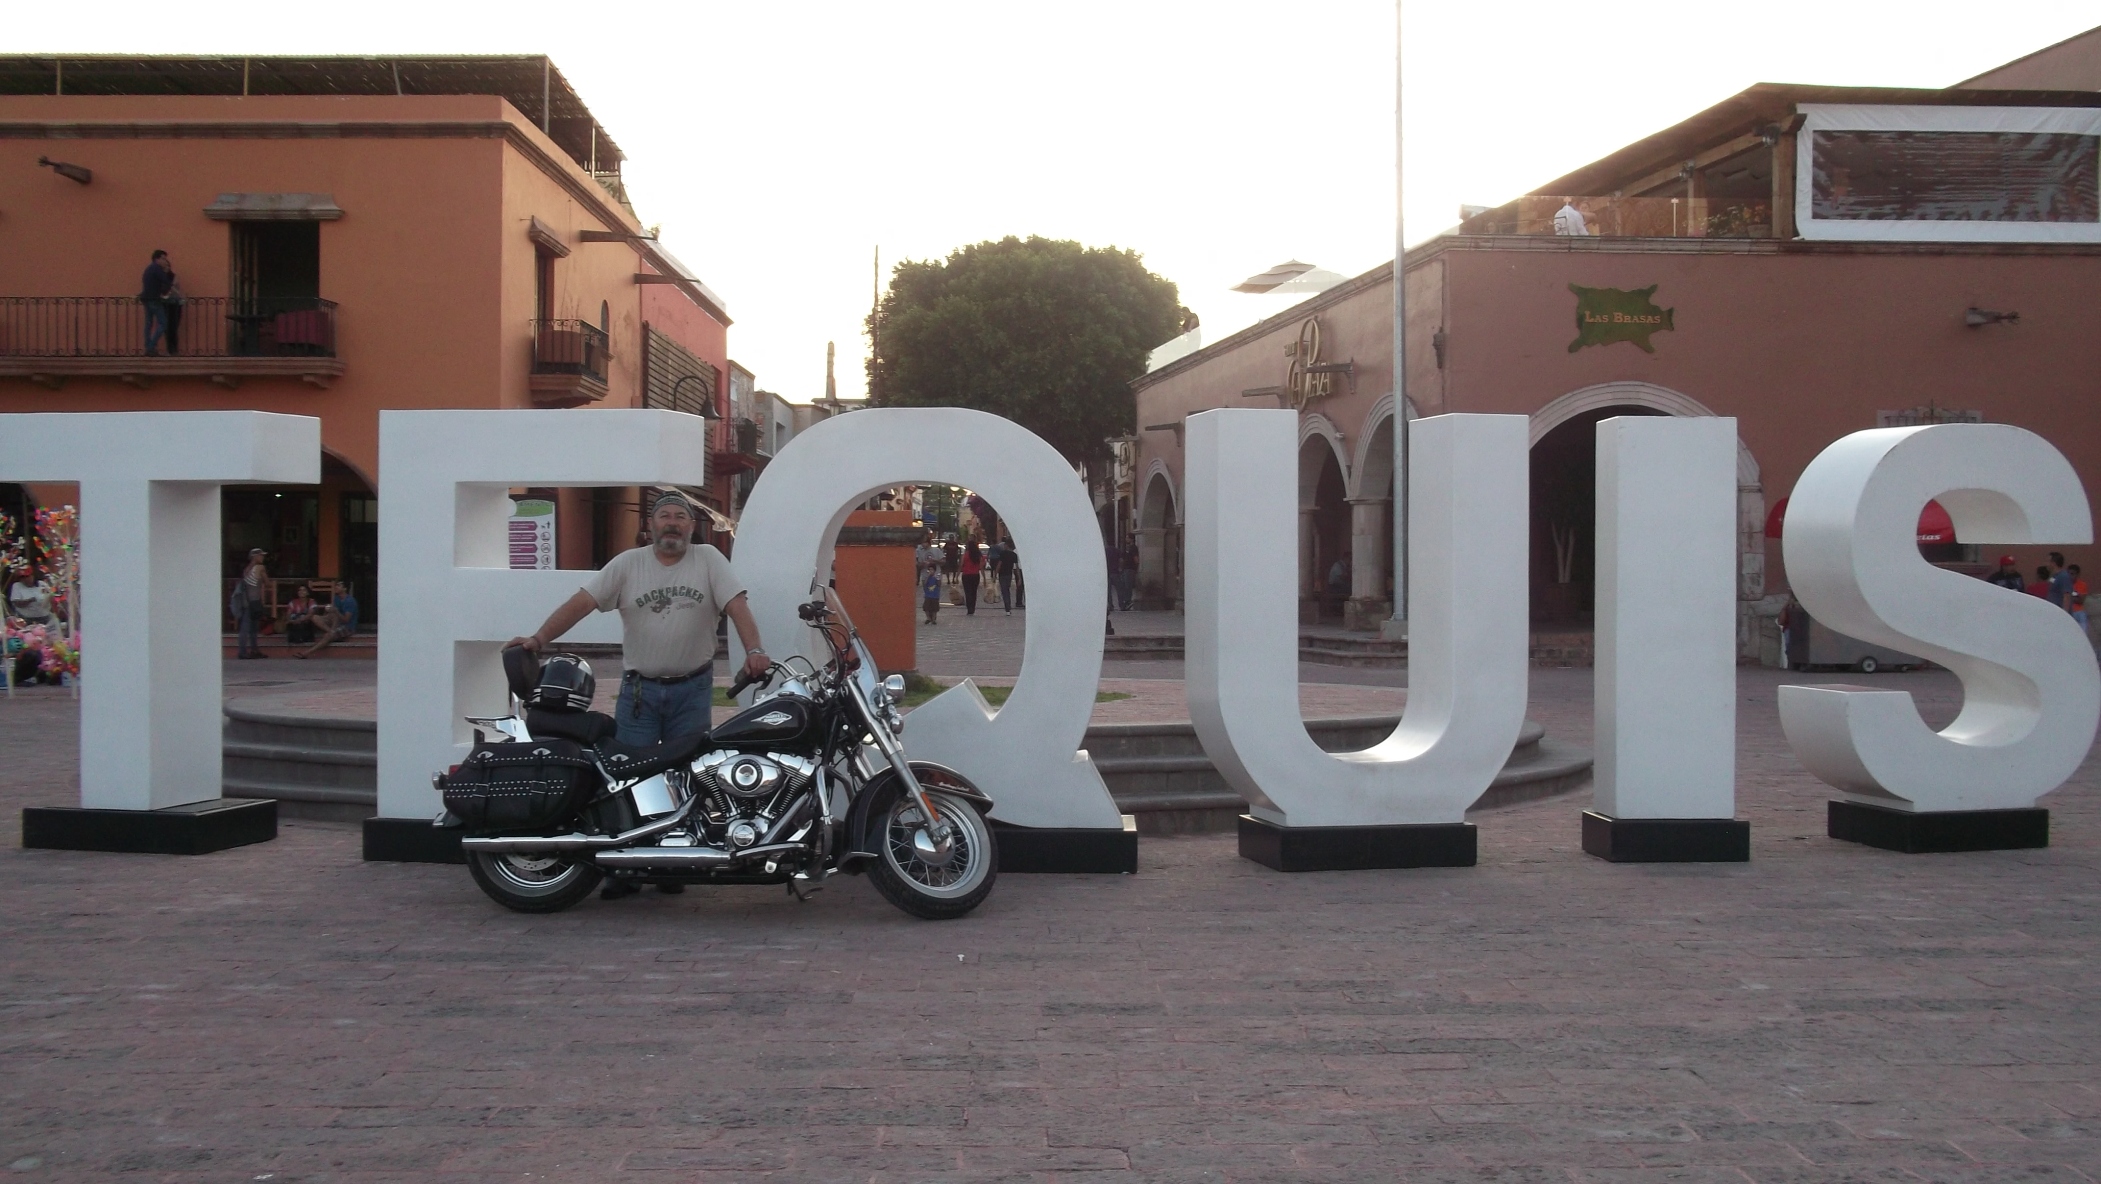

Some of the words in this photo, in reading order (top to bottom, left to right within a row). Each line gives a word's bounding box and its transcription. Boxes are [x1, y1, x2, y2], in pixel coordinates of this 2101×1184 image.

[1584, 310, 1609, 324] LAS
[1613, 311, 1661, 325] BRASAS
[635, 585, 705, 608] BACKPACKER
